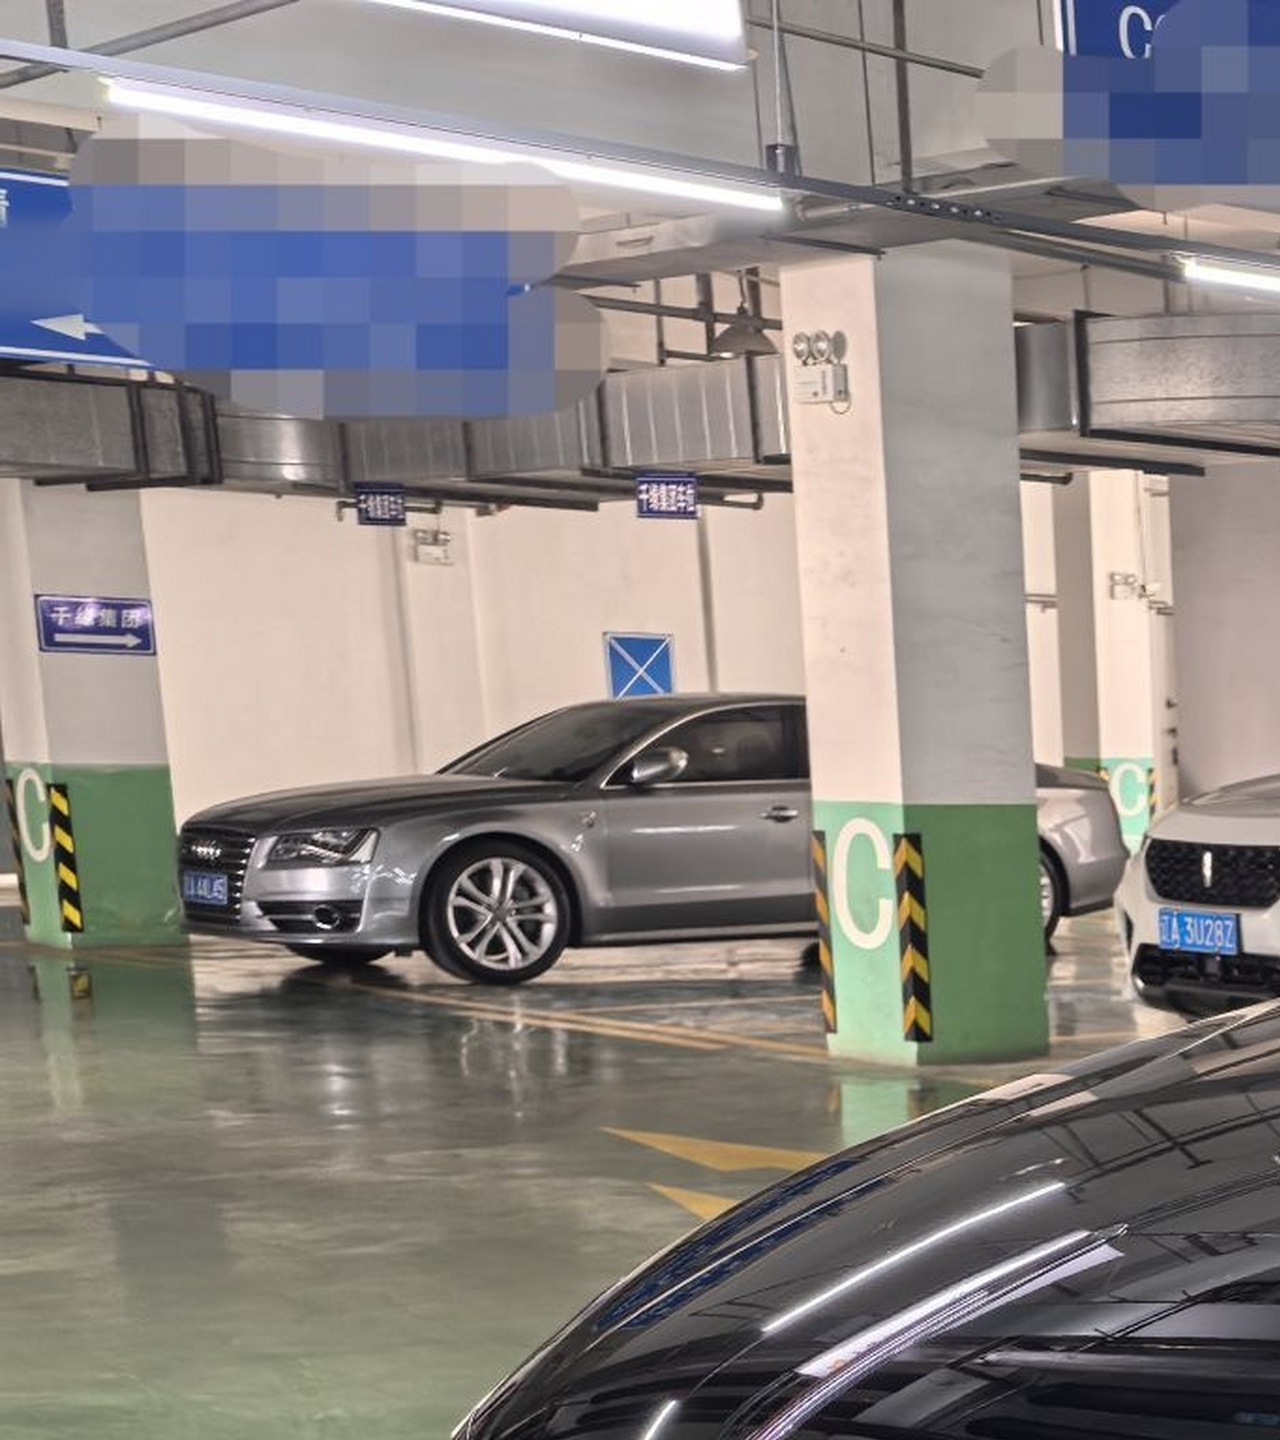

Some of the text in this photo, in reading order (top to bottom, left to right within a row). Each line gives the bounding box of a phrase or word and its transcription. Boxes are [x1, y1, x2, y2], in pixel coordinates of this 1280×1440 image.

[16, 768, 51, 862] C
[1108, 763, 1148, 815] C
[832, 817, 894, 950] C
